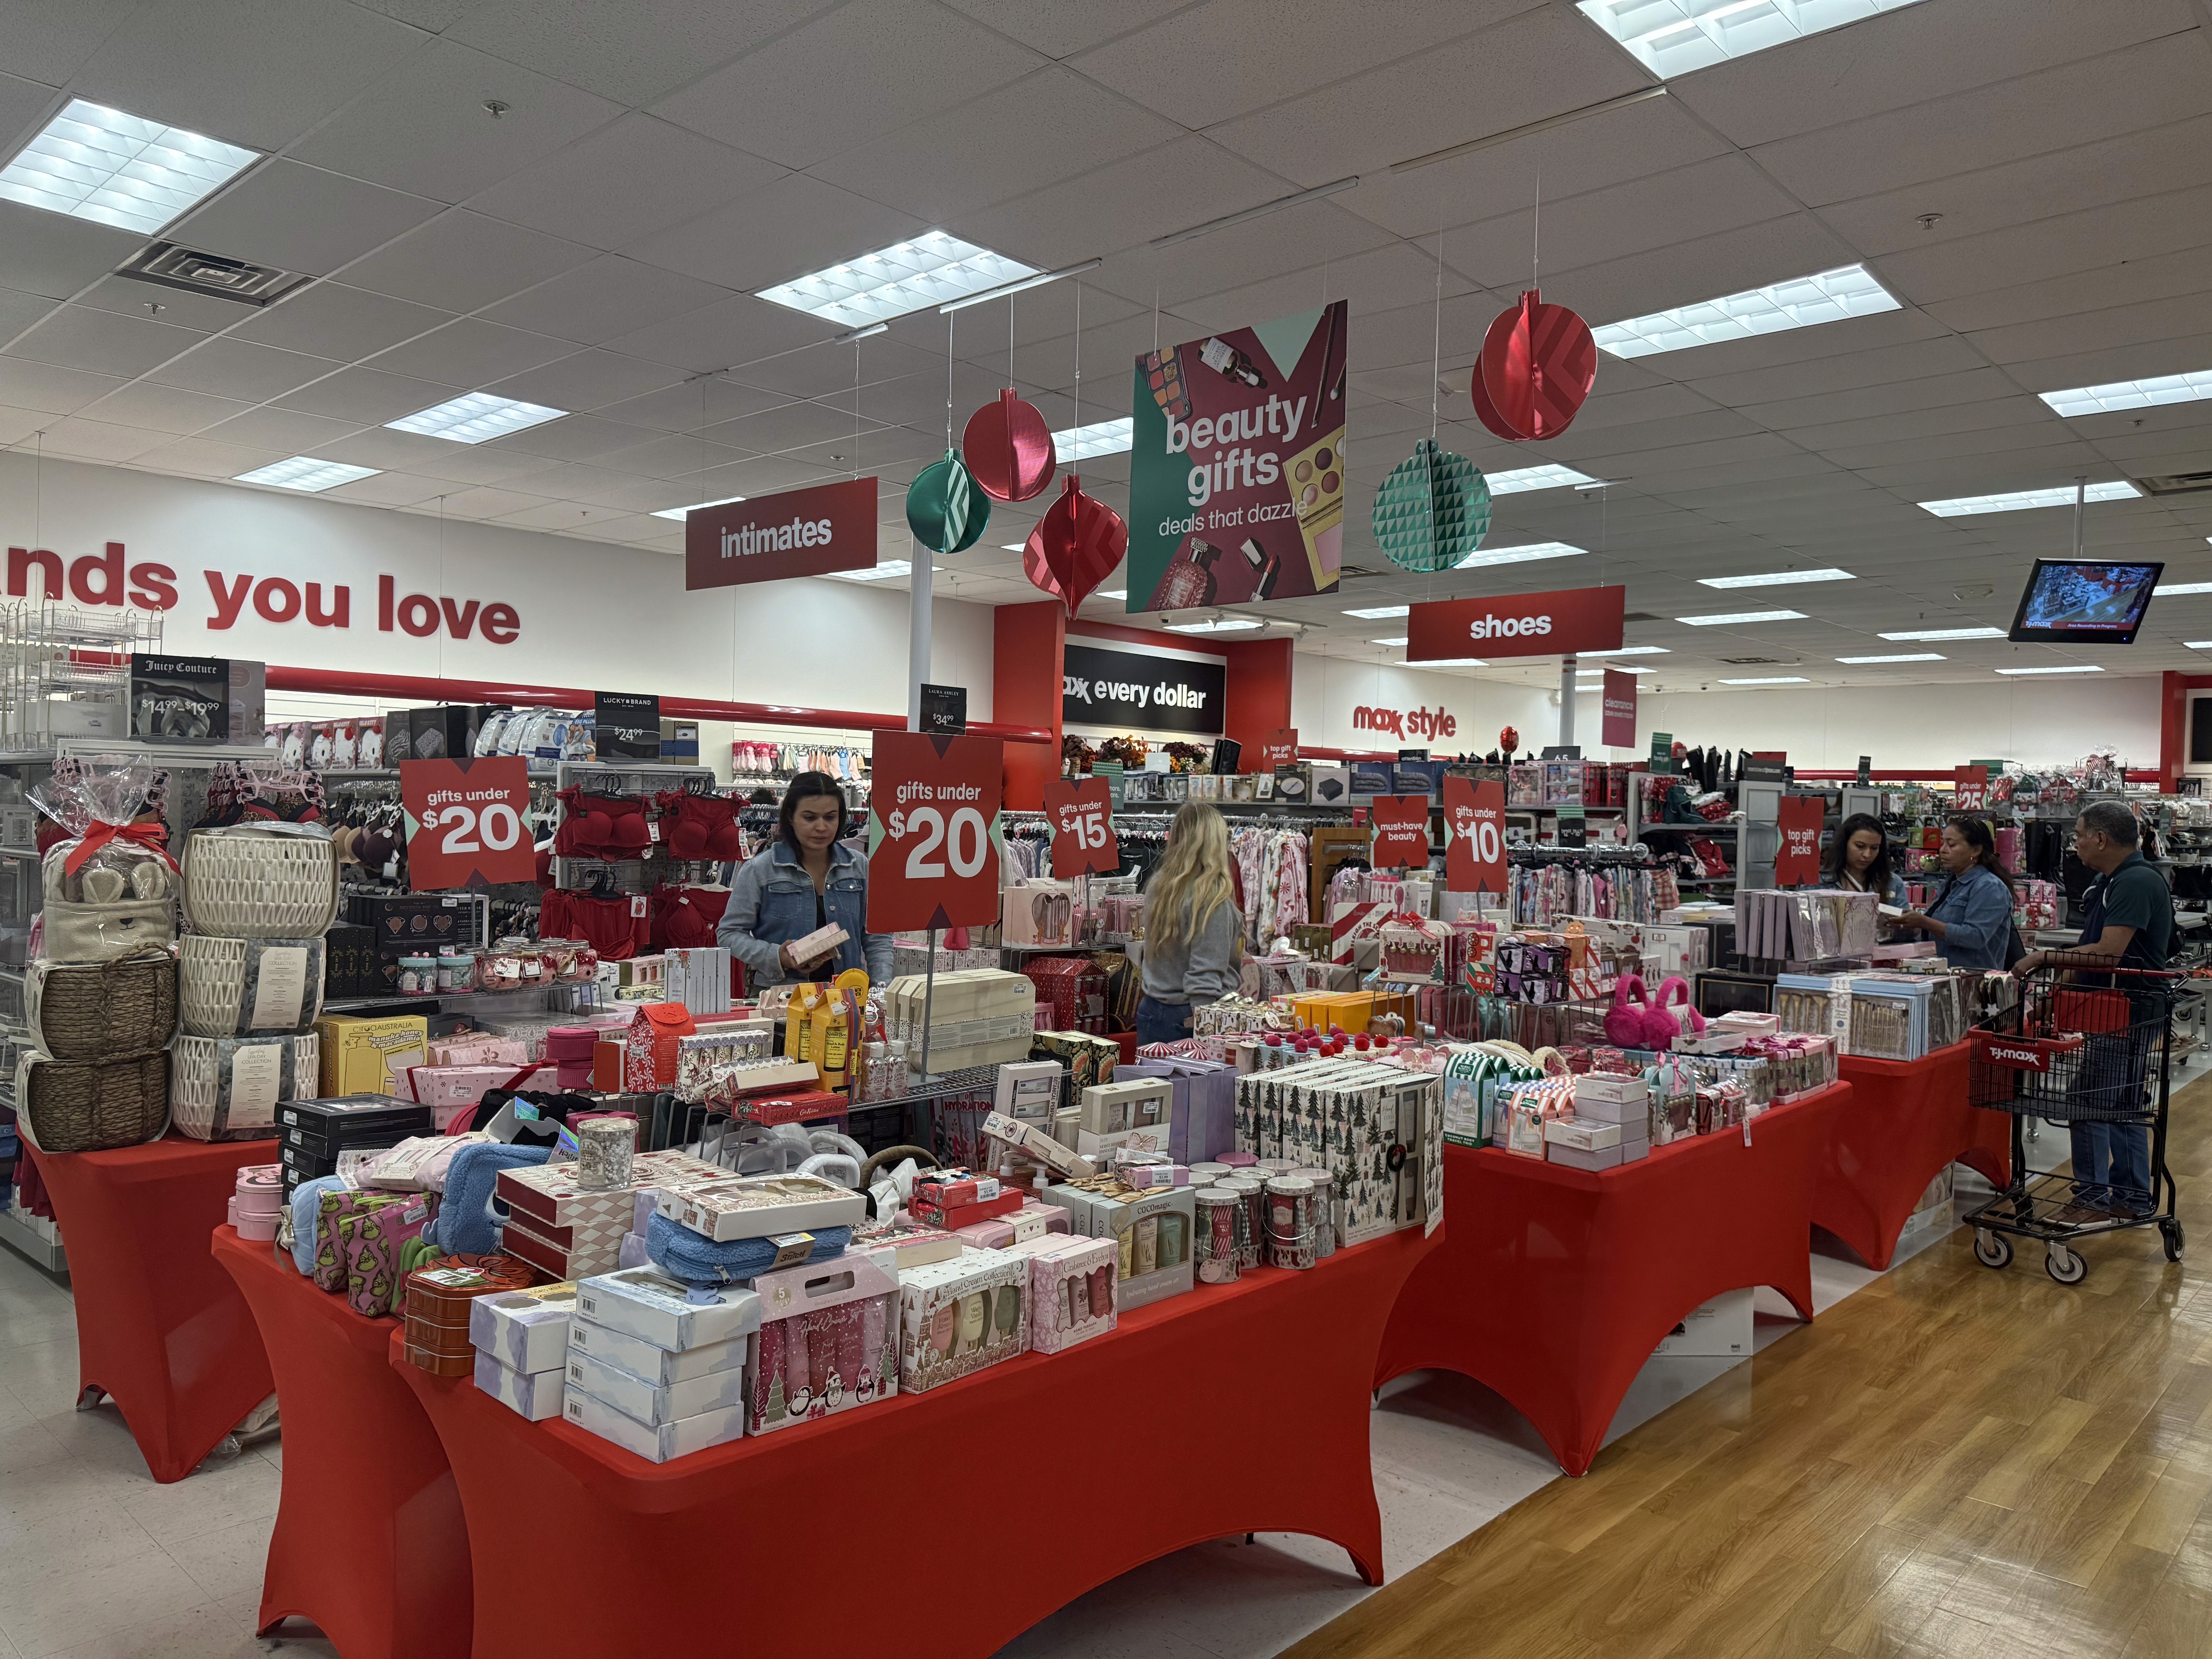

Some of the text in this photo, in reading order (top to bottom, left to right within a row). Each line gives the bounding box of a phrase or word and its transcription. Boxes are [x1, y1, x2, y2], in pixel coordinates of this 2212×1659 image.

[1166, 393, 1308, 455] beauty
[1187, 448, 1279, 507] gifts
[1158, 497, 1308, 537] deals that dazzle
[720, 516, 832, 559] intimates
[0, 542, 520, 644] nds you love
[1470, 613, 1552, 639] shoes
[145, 660, 217, 674] Juicy Couture
[1063, 675, 1207, 710] axx every dollar
[1604, 697, 1634, 710] clearance
[1353, 705, 1457, 742] maxx style
[427, 788, 510, 806] gifts under
[896, 781, 982, 802] gifts under
[1960, 782, 1969, 791] gifts
[1059, 800, 1102, 815] gifts under
[1958, 791, 1981, 810] $25
[1456, 805, 1496, 819] gifts under
[422, 803, 520, 855] $20
[1061, 812, 1108, 850] $15
[1380, 821, 1424, 832] must-have
[1388, 831, 1417, 843] beauty
[1788, 829, 1815, 843] top gift
[888, 807, 988, 879] $20
[1456, 820, 1499, 864] $10
[1791, 843, 1811, 857] picks
[368, 1030, 424, 1042] manuka honey
[378, 1036, 421, 1048] macadamia
[1063, 1251, 1109, 1273] Crabtree & Evelyn
[778, 1287, 785, 1299] 5
[947, 1269, 1010, 1296] Hand Cream Collection
[1126, 1286, 1147, 1298] hydrating
[1147, 1282, 1159, 1291] hand
[1159, 1279, 1173, 1288] cream
[800, 1314, 848, 1340] Hand Cream
